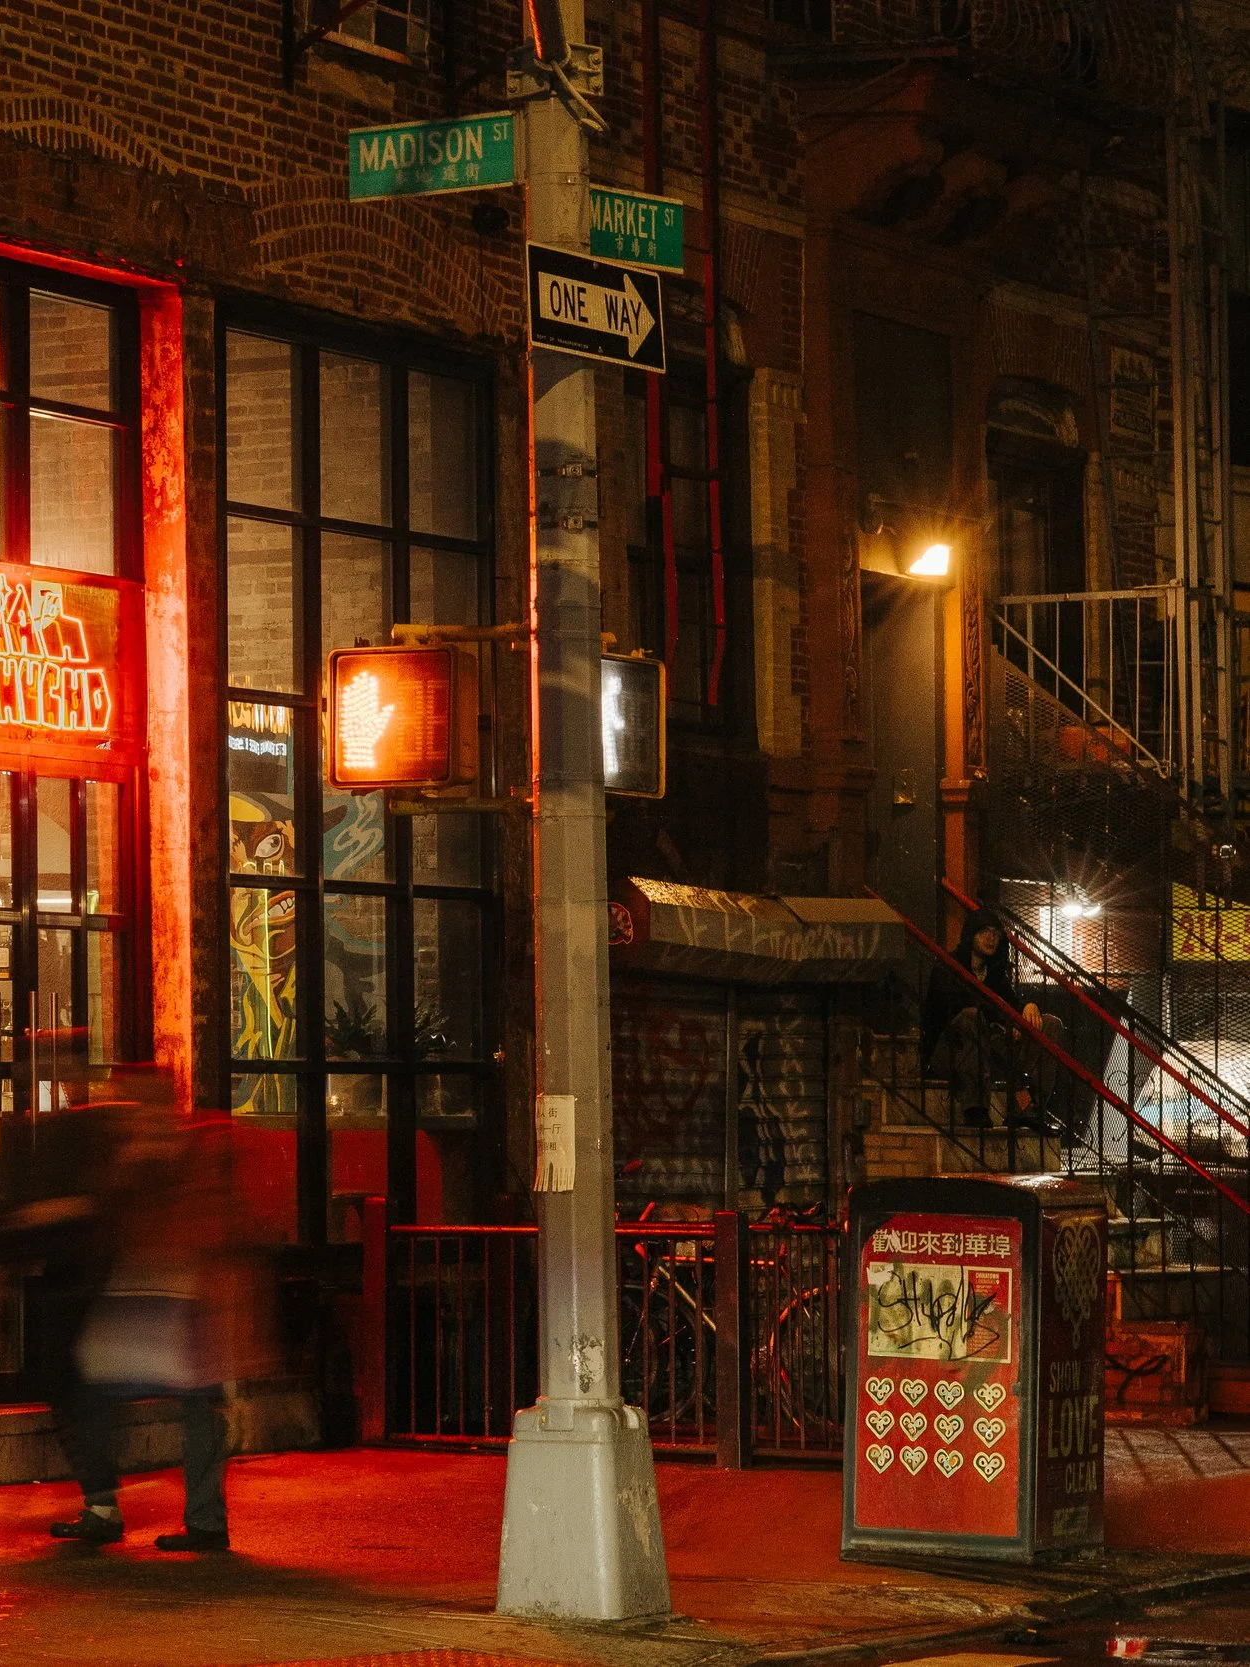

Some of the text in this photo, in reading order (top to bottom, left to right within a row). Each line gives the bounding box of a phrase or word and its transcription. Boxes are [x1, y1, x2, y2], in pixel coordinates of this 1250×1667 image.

[358, 123, 508, 174] MADISON ST
[590, 194, 675, 241] MARKET ST
[550, 280, 642, 336] ONE WAY
[872, 1229, 1011, 1258] 歡迎來到華埠
[1049, 1360, 1081, 1393] SHOW
[1047, 1395, 1099, 1458] LOVE
